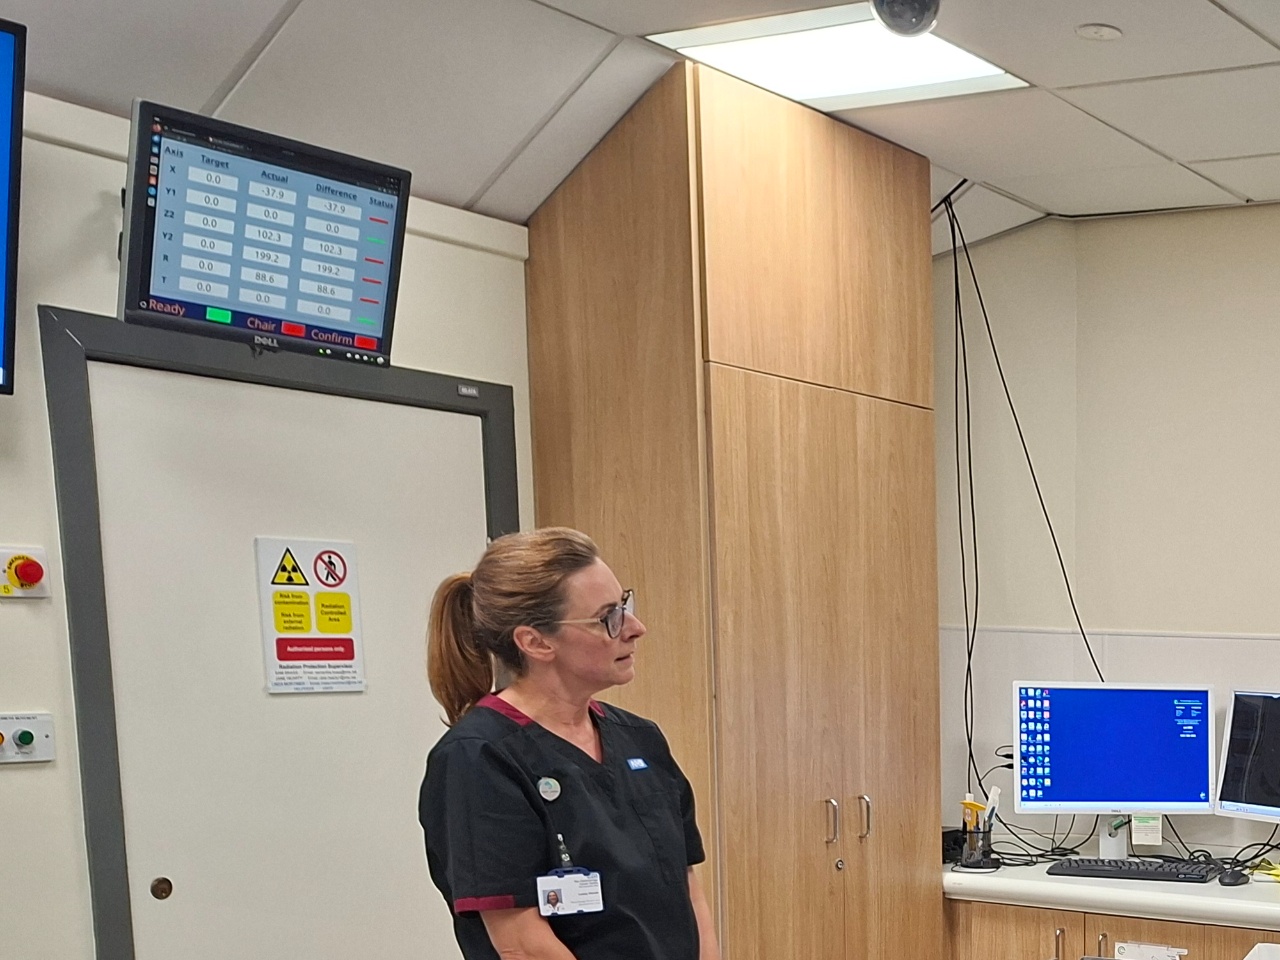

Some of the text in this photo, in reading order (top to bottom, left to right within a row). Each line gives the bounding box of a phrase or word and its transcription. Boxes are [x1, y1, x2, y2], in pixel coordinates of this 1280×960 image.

[165, 146, 394, 210] Axis Target Actual Difference Status
[170, 166, 346, 214] X 0.0 -37.9 -37.9
[165, 188, 340, 234] Y1 0.0 0.0 0.0
[162, 232, 341, 276] Y2 0.0 199.2 199.2
[164, 210, 343, 256] Z2 0.0 102.3 102.3
[161, 276, 331, 316] T 0.0 0.0 0.0
[162, 254, 336, 296] R 0.0 88.6 88.6
[150, 300, 186, 317] Ready
[247, 316, 276, 332] Chair
[254, 336, 280, 348] DELL
[311, 328, 353, 346] Confirm
